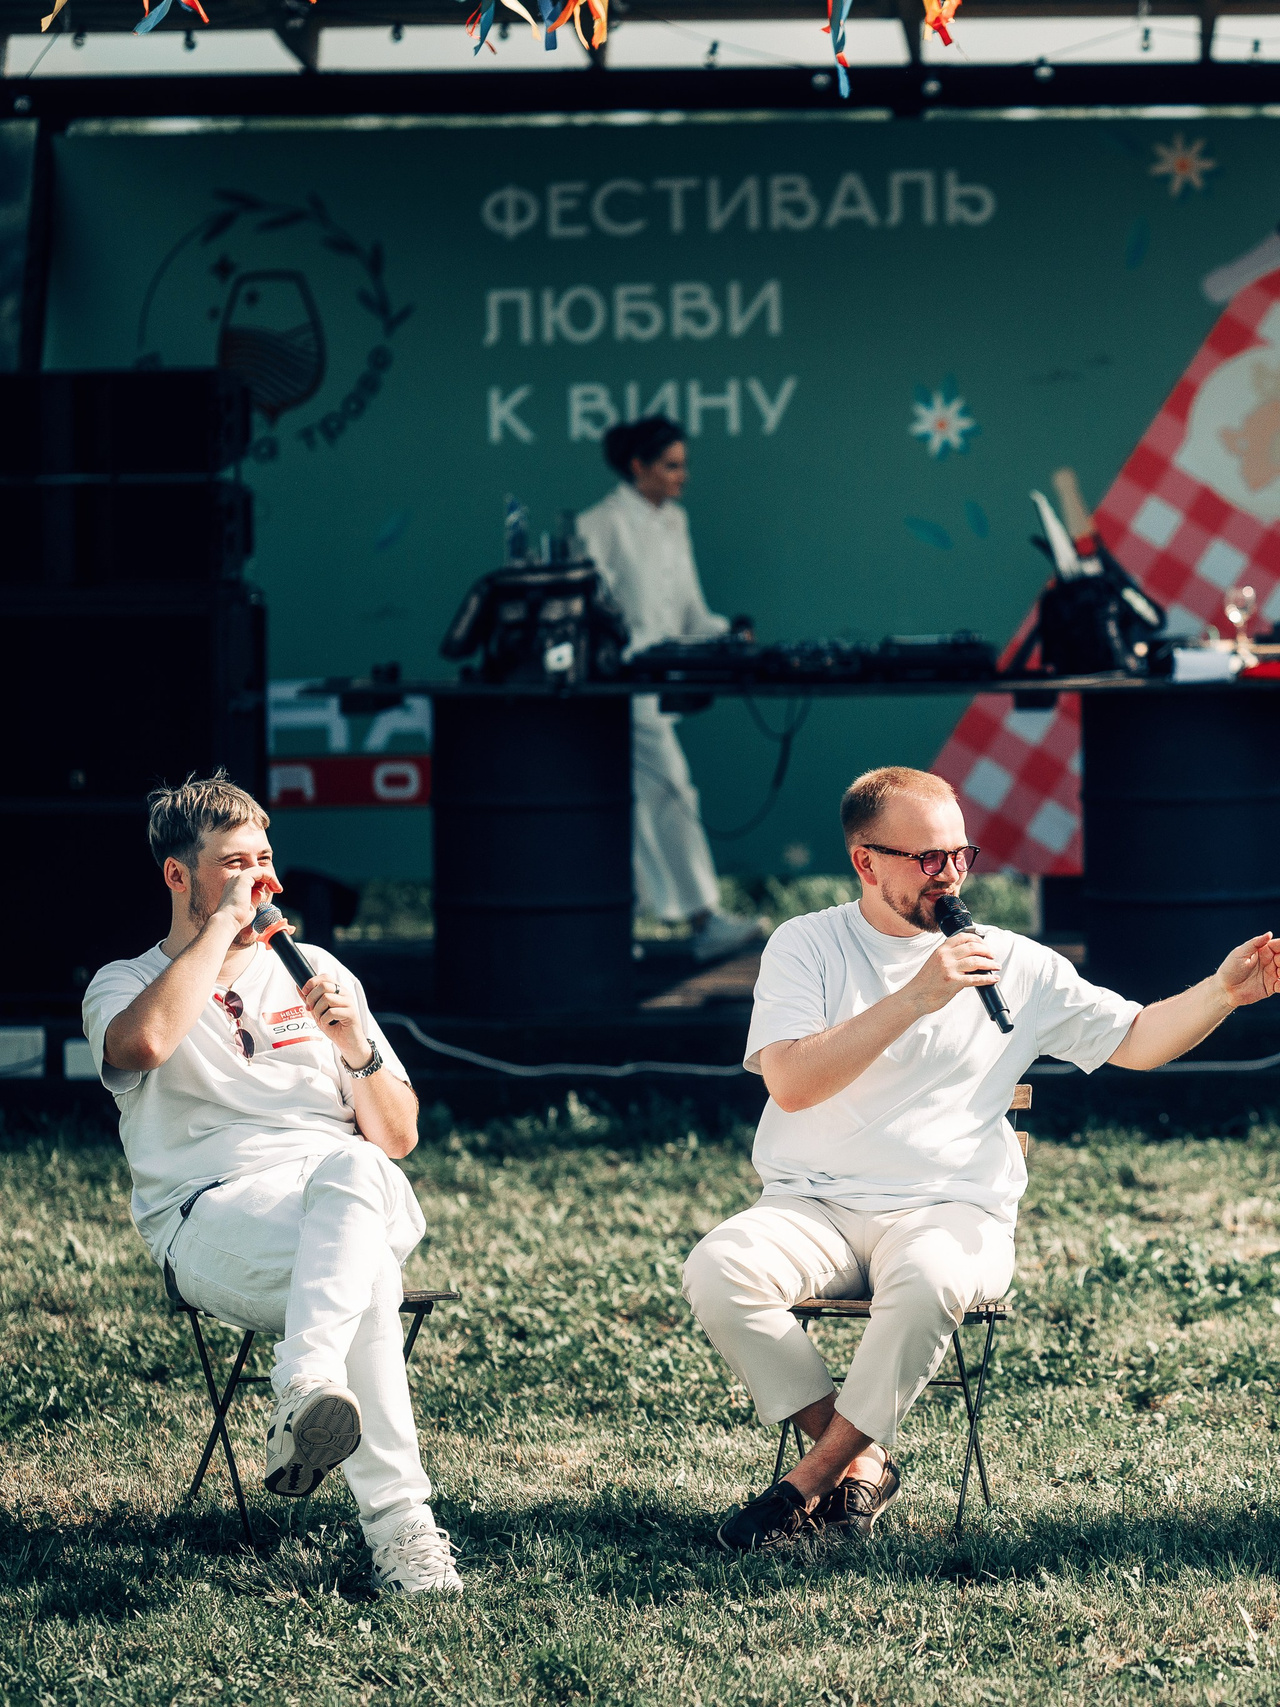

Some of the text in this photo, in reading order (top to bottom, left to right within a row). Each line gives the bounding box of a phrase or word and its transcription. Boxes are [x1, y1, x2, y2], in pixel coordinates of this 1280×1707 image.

[482, 171, 996, 238] ФЕСТИВАЛЬ
[485, 281, 781, 345] ЛЮБВИ
[489, 376, 797, 444] К ВИНУ
[280, 1008, 305, 1018] HELLO
